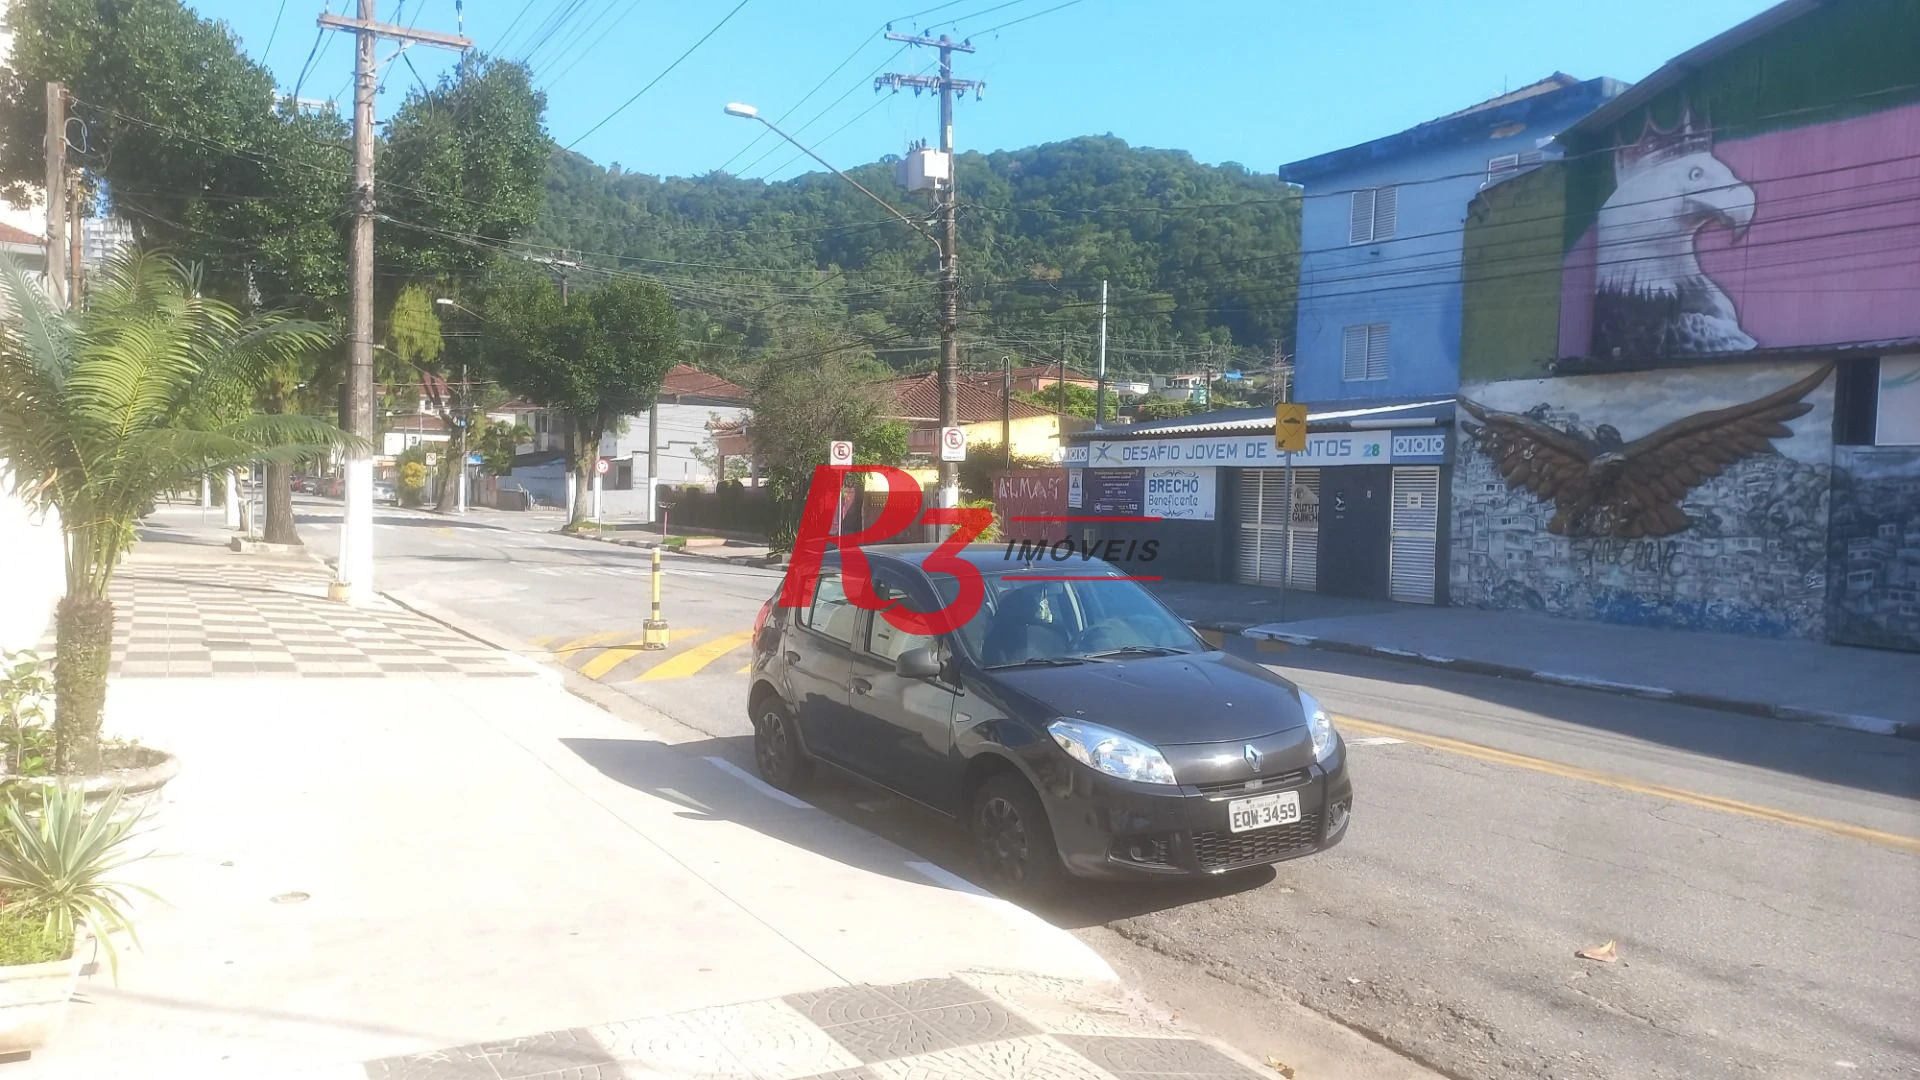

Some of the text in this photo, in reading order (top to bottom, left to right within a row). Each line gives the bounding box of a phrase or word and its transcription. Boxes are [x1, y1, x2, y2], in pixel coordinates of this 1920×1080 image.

[1122, 438, 1352, 461] DESAFIO JOVEM DE NTOS
[1363, 443, 1380, 457] 28
[1148, 476, 1199, 494] BRECHÓ
[1148, 494, 1198, 507] Beneficente
